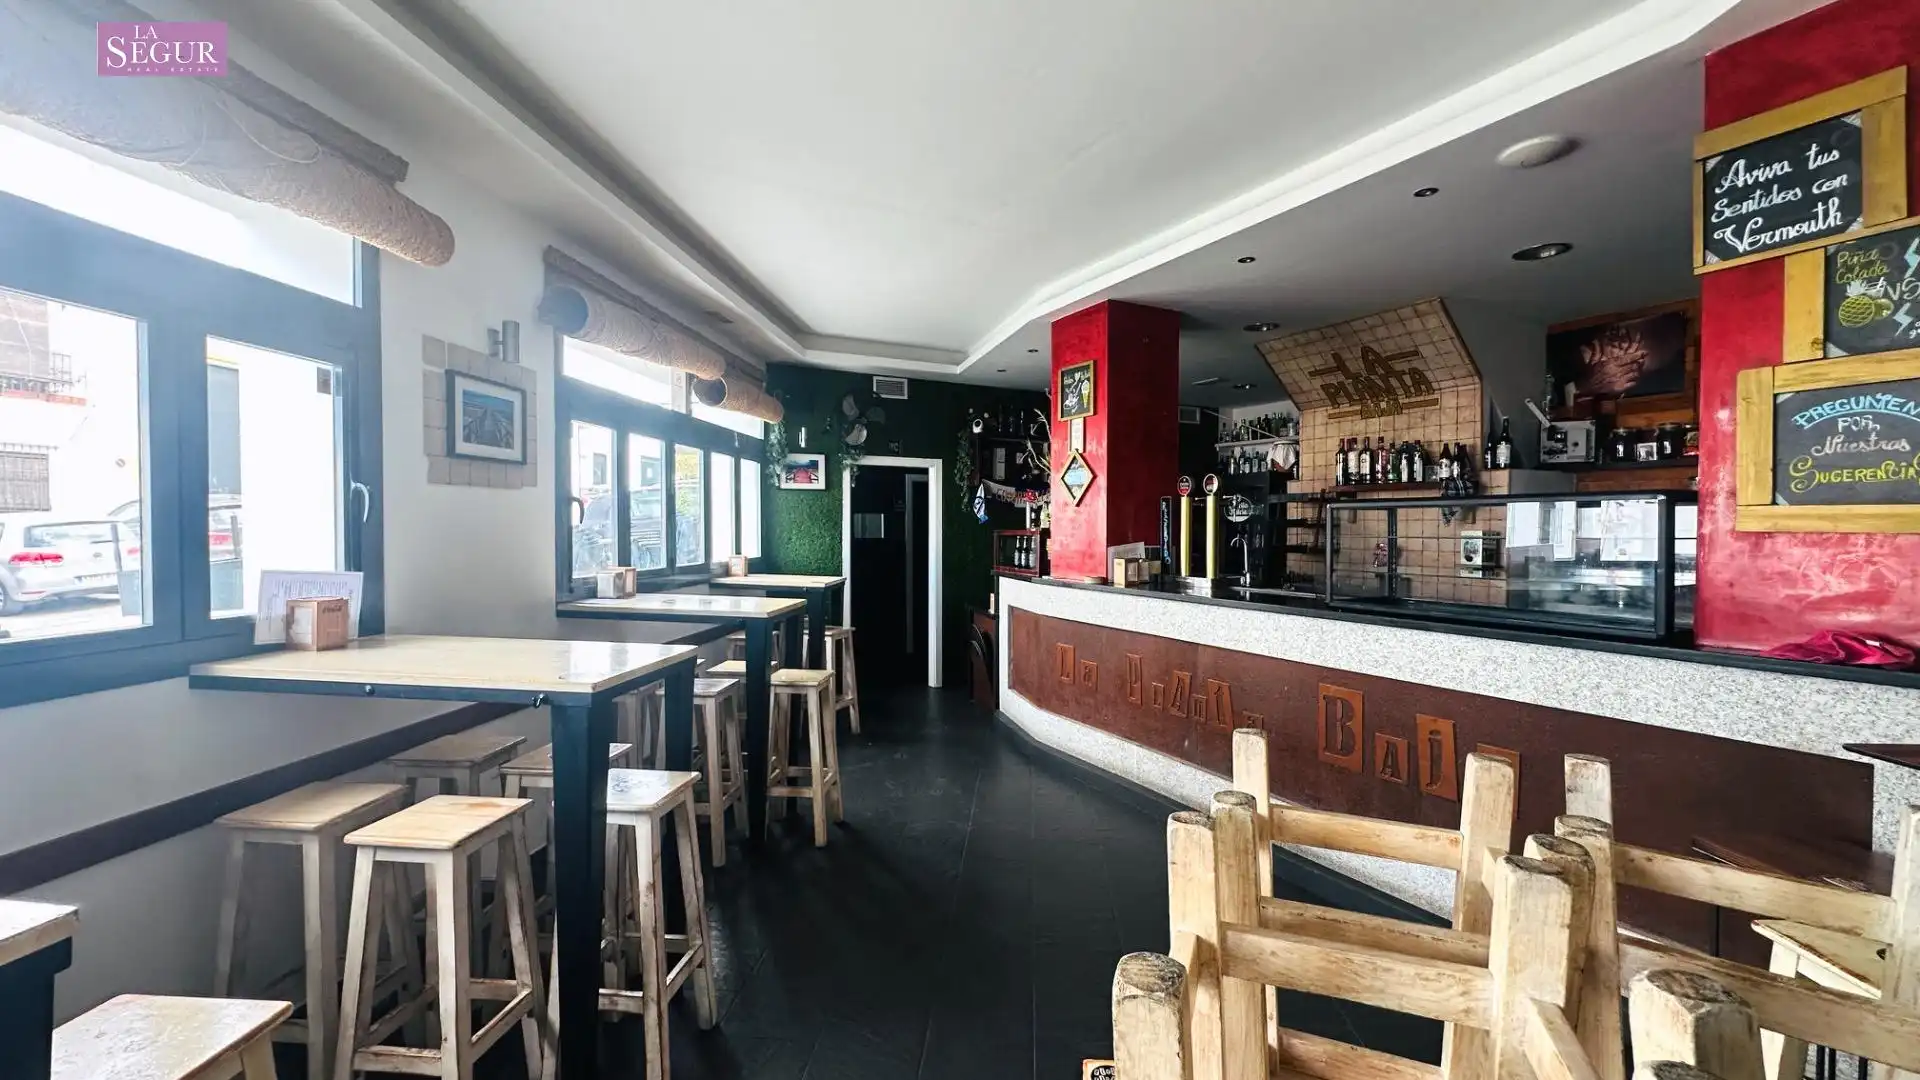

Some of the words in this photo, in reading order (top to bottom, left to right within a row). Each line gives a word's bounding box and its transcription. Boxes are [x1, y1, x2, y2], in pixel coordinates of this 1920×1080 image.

[1715, 159, 1792, 194] Aviva
[1805, 143, 1841, 170] tus
[1711, 184, 1802, 223] Sentidos
[1812, 173, 1848, 194] con
[1713, 197, 1844, 254] Vermouth
[1836, 260, 1890, 285] Colada
[1330, 345, 1396, 380] LA
[1811, 431, 1912, 456] Nuestras
